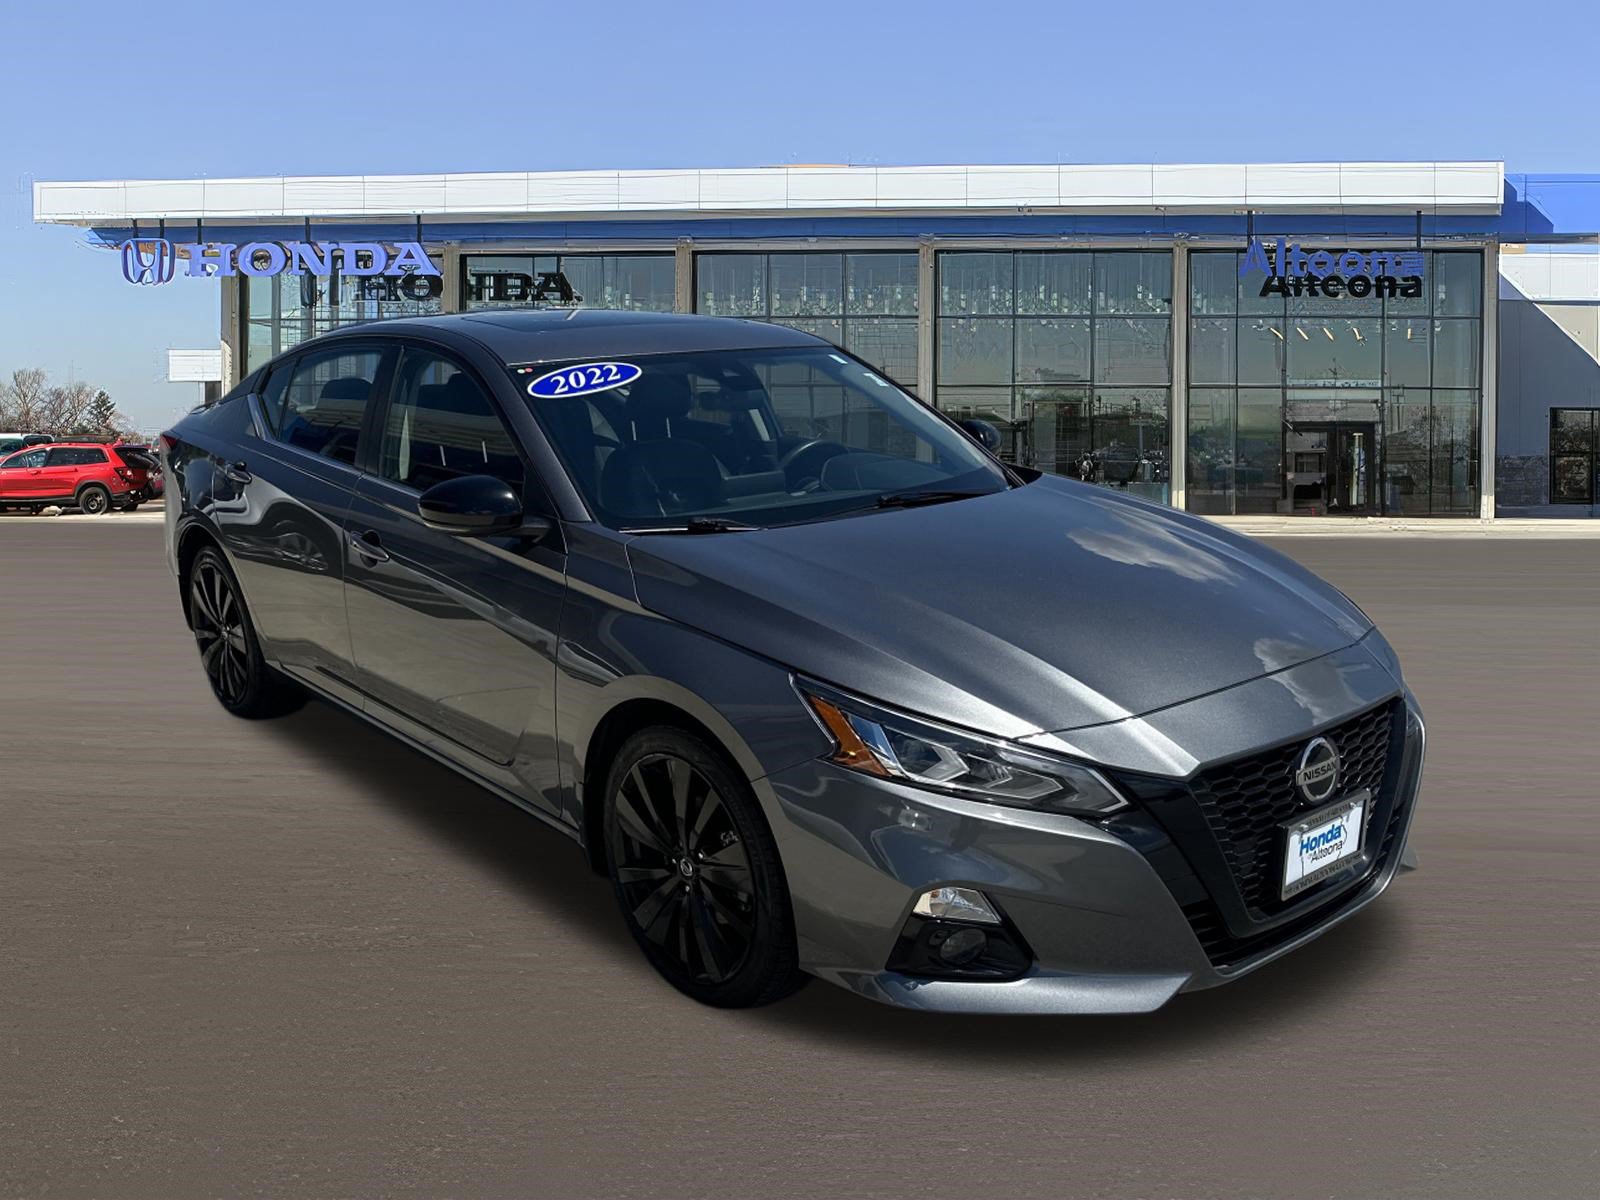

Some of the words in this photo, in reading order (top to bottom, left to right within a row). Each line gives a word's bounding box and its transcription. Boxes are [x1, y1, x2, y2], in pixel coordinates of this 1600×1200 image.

[185, 241, 442, 276] HONDA
[550, 364, 621, 394] 2022
[1303, 760, 1337, 783] NISSAN
[1299, 824, 1341, 856] Honda
[1310, 840, 1343, 863] Altoona
